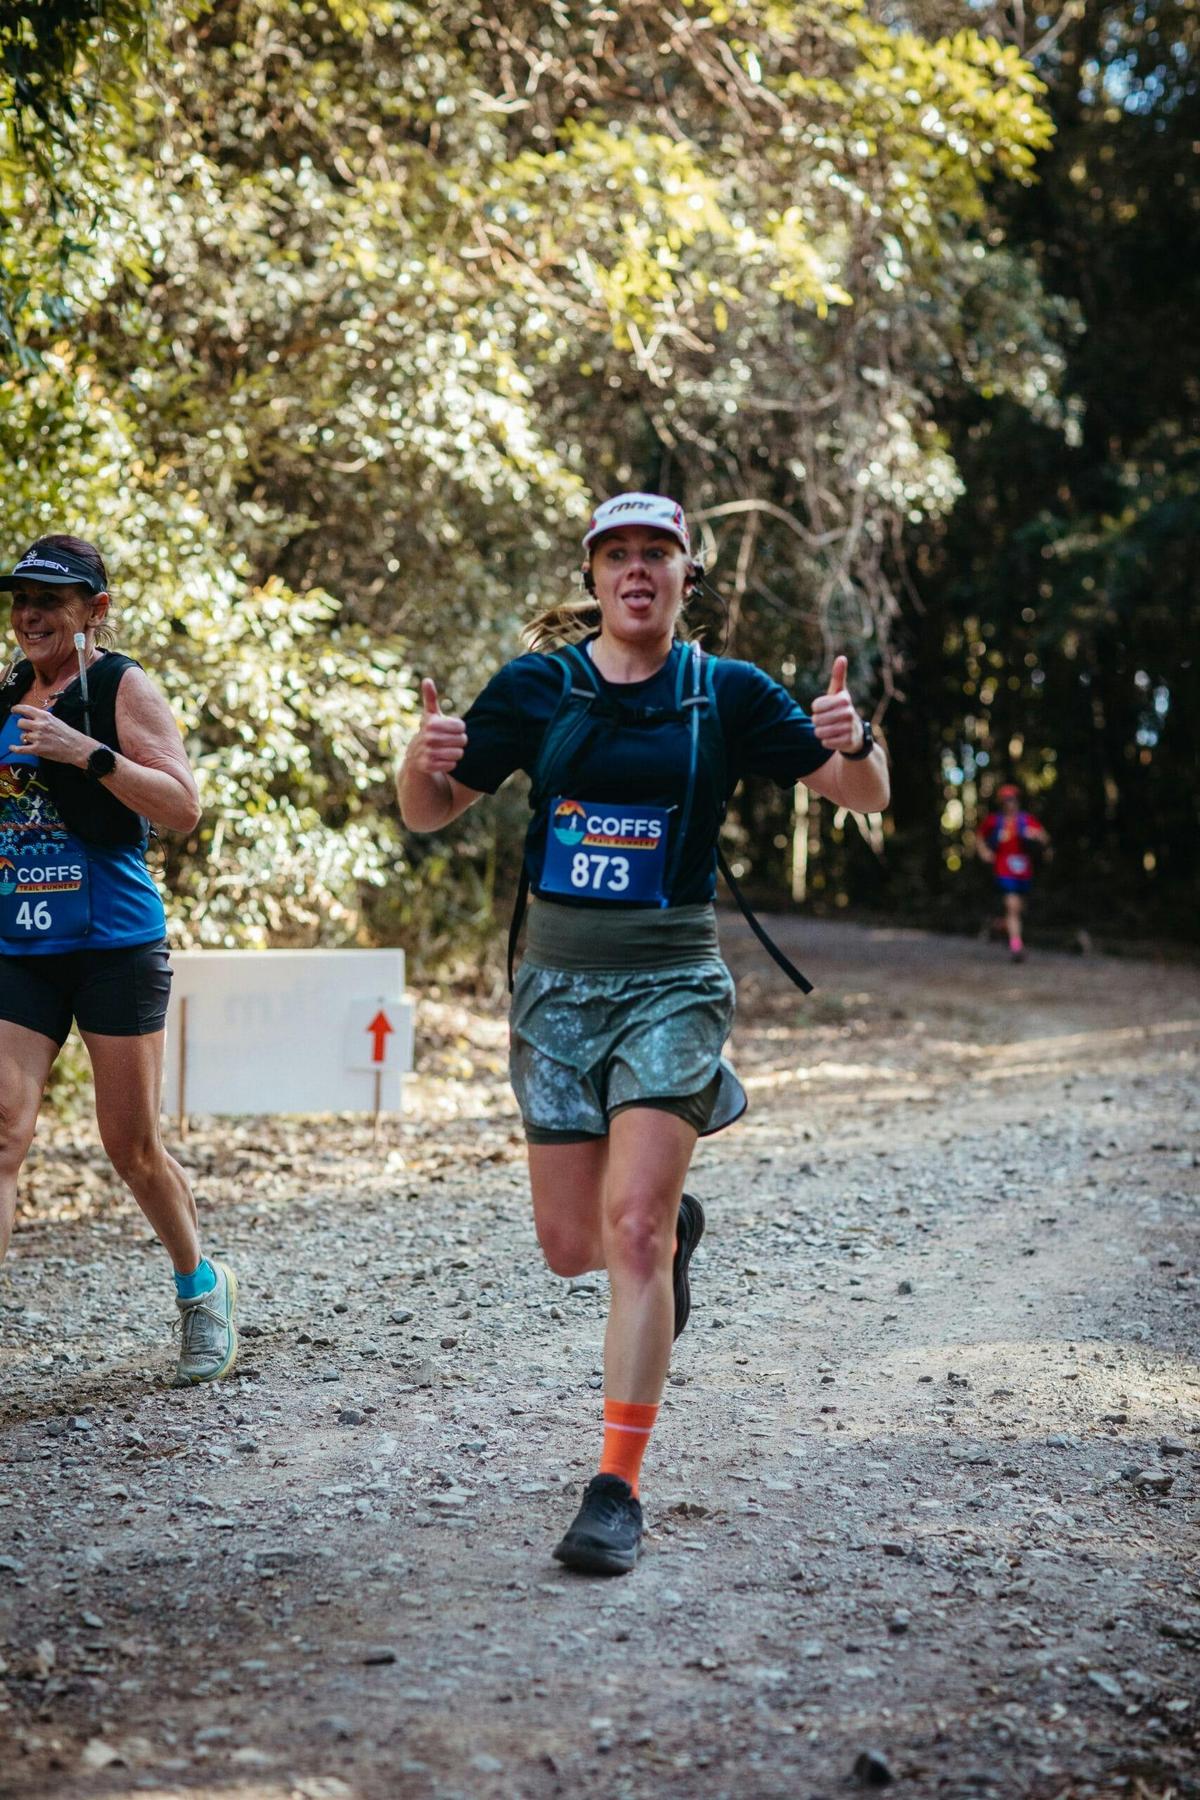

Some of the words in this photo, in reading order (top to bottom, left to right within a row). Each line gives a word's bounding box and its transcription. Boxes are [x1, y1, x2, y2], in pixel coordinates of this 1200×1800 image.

[586, 816, 662, 838] COFFS
[17, 865, 83, 883] COFFS
[570, 852, 630, 891] 873
[42, 883, 78, 891] RUNNERS
[15, 901, 52, 931] 46
